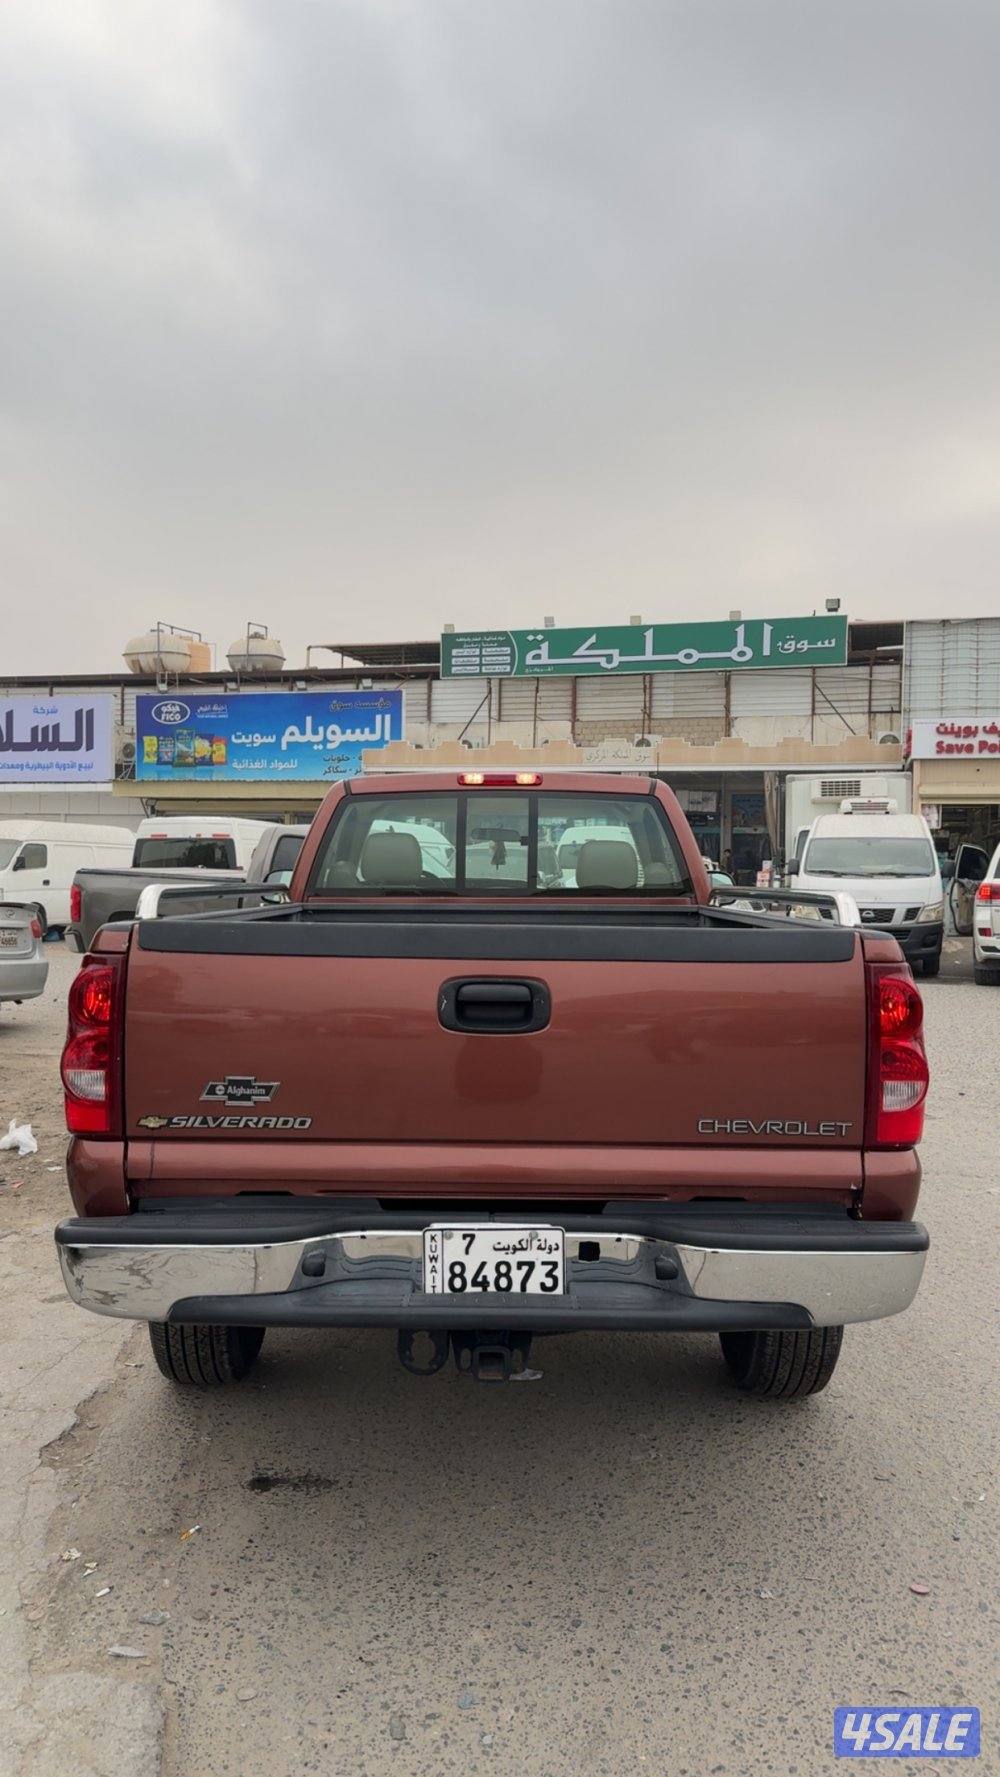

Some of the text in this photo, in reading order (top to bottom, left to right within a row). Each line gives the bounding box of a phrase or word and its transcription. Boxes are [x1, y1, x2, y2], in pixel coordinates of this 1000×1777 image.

[525, 622, 836, 670] سوق المملكة
[32, 705, 58, 716] شركة
[161, 713, 181, 721] FICO
[231, 714, 391, 750] السويلم سويت
[936, 722, 979, 739] بوينت
[936, 740, 975, 754] Save
[25, 760, 54, 772] البيطرية
[77, 761, 94, 772] لبيع
[231, 757, 298, 771] للمواد الغذائية
[322, 754, 350, 765] حلويات
[322, 765, 347, 776] سكاكر
[226, 1085, 266, 1096] Alghanim
[169, 1116, 312, 1129] SILVERADO
[698, 1119, 853, 1136] CHEVROLET
[462, 1233, 476, 1255] 7
[492, 1236, 560, 1255] دولة الكويت
[428, 1234, 439, 1293] KUWAIT
[447, 1260, 559, 1293] 84873
